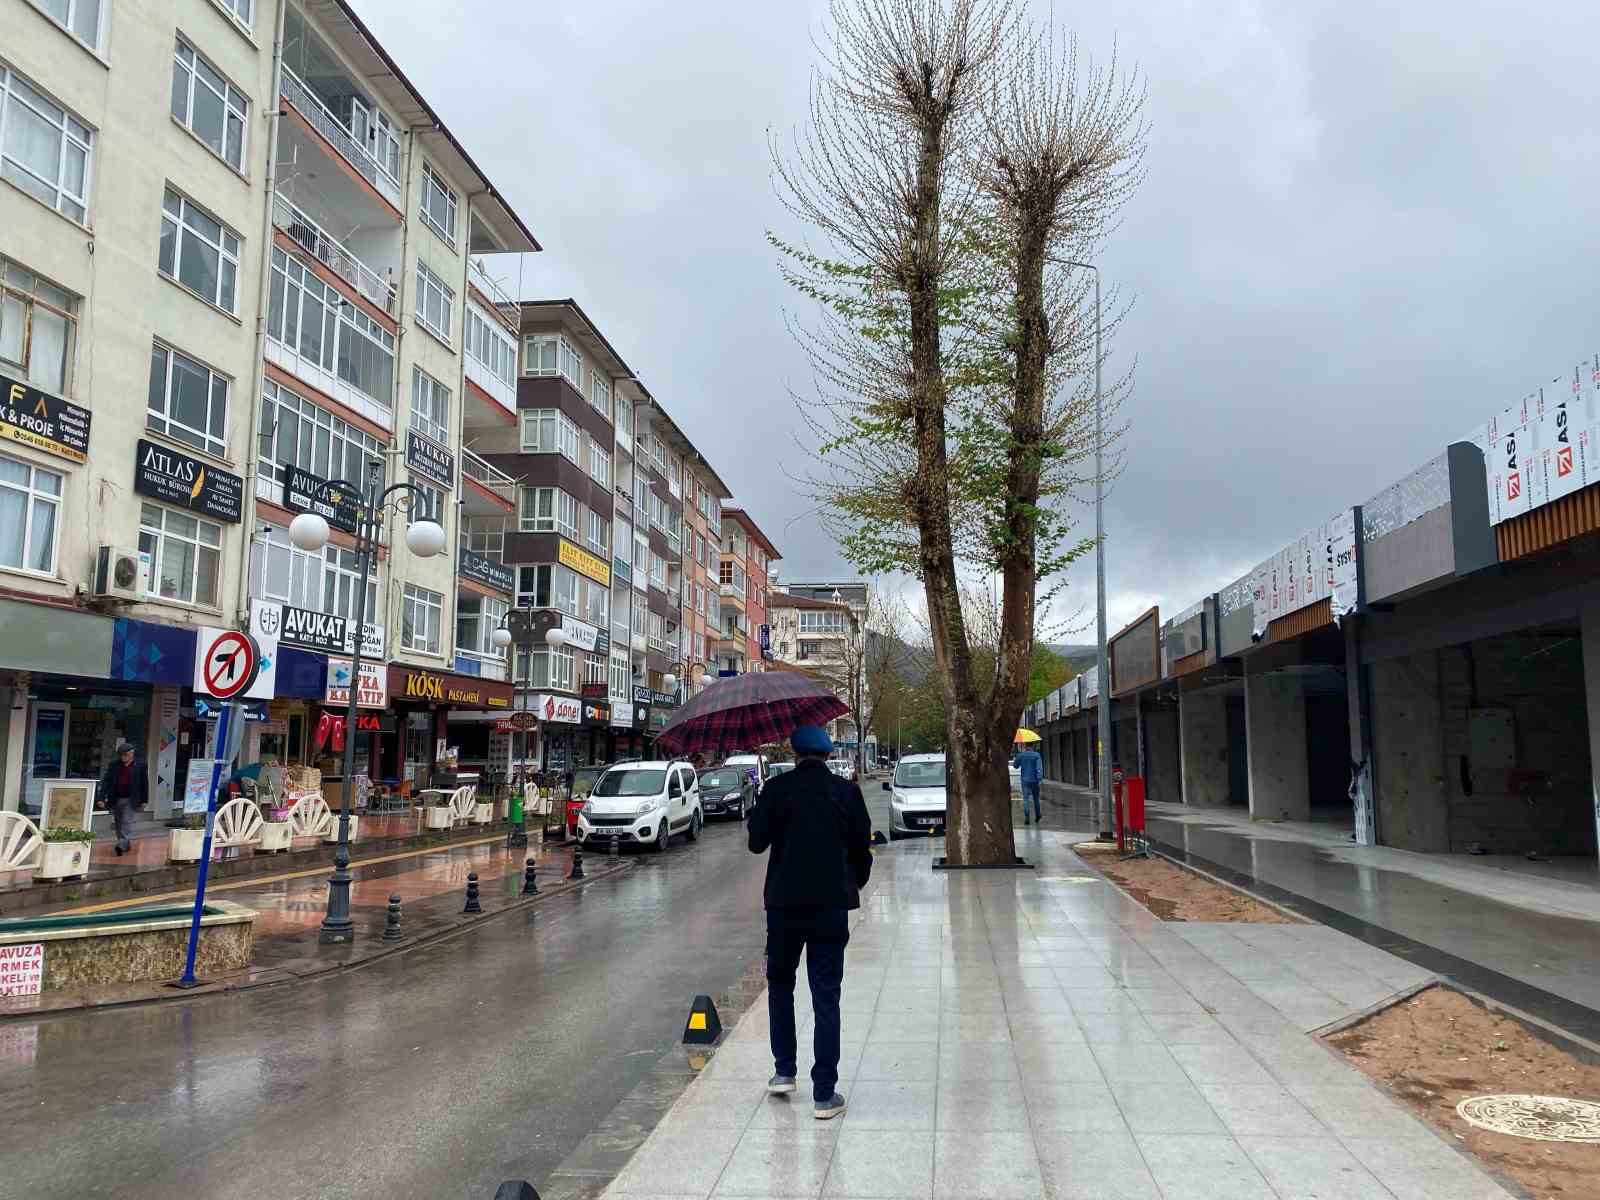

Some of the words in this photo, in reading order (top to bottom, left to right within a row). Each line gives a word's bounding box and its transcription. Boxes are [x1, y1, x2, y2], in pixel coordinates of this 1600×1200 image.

[8, 409, 18, 423] &
[20, 413, 54, 437] PROJE
[143, 446, 194, 482] ATLAS
[412, 437, 449, 466] AVUKAT
[285, 608, 344, 640] AVUKAT
[406, 671, 445, 700] KÖŞK
